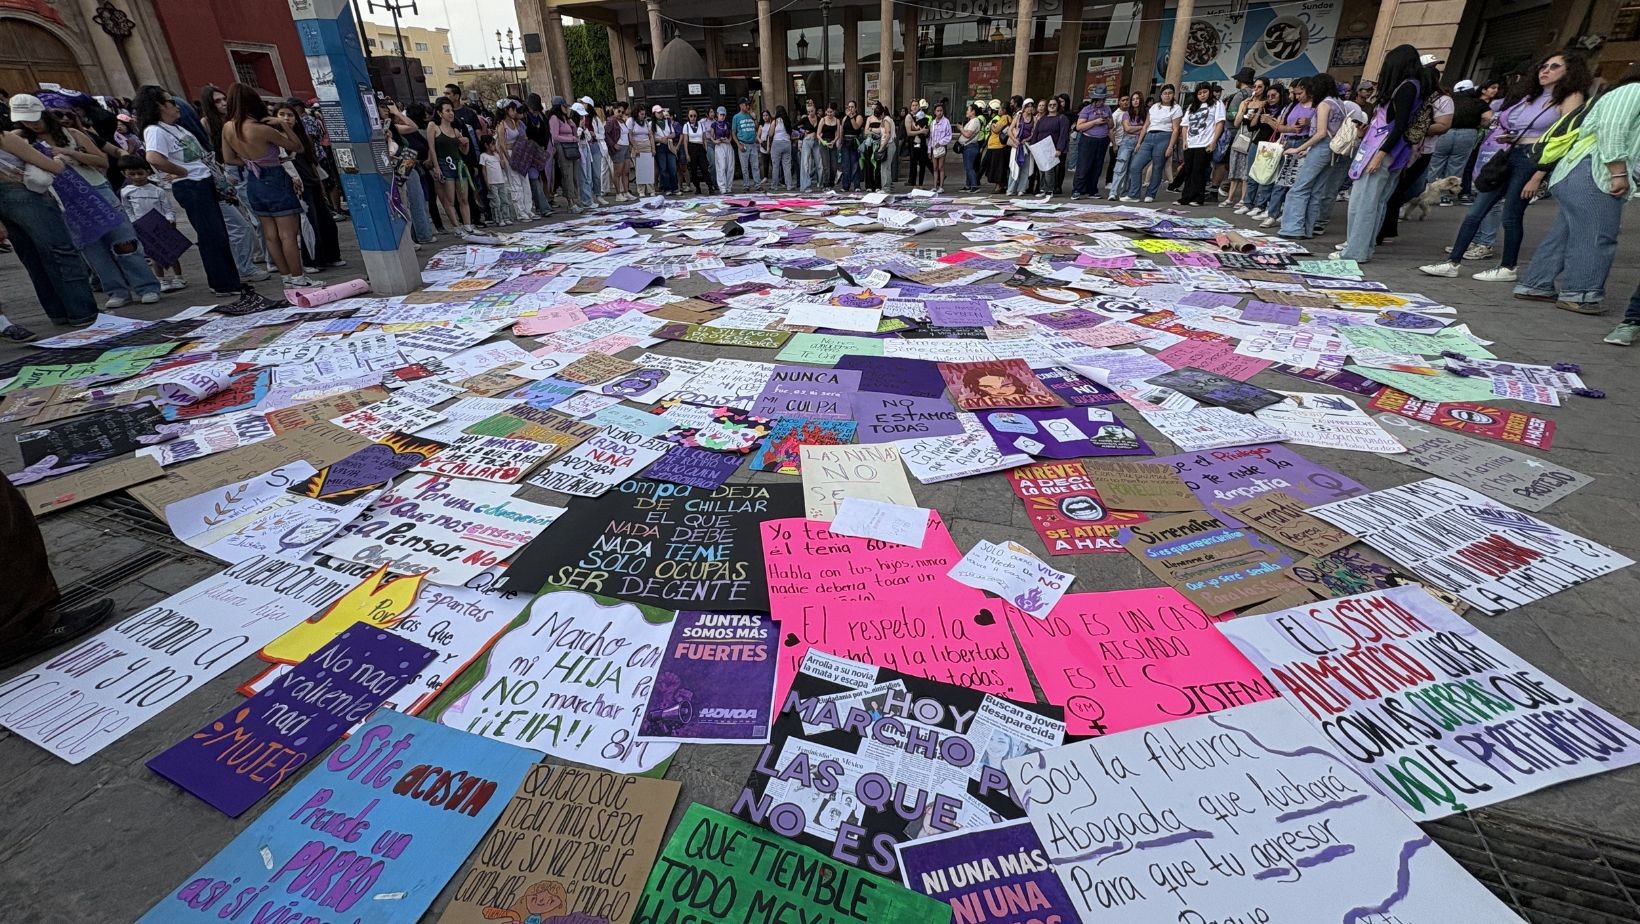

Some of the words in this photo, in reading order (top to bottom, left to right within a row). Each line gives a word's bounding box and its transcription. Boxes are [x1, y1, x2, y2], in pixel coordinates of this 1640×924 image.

[772, 371, 840, 385] NUNCA
[785, 400, 838, 414] CULPA
[876, 411, 957, 423] ESTAMOS
[869, 423, 930, 434] TODAS
[585, 449, 633, 468] NUNCA
[806, 449, 840, 463] LAS
[822, 463, 878, 481] NO
[1014, 464, 1087, 480] ATRÉVET
[709, 485, 770, 499] DEJA
[811, 486, 845, 502] SE
[1022, 487, 1039, 495] LO
[1042, 487, 1070, 495] QUE
[633, 497, 671, 511] DE
[684, 500, 768, 513] CHILLAR
[604, 520, 660, 539] NADA
[670, 527, 737, 543] DEBE
[645, 511, 675, 525] EL
[683, 514, 733, 528] QUE
[769, 523, 792, 541] Yo
[1046, 529, 1071, 539] SE
[1056, 540, 1072, 550] A
[462, 549, 497, 567] No
[592, 535, 652, 557] NADA
[665, 543, 734, 561] TEME
[980, 543, 1004, 557] SOLO
[579, 551, 647, 574] SOLO
[655, 560, 750, 581] OCUPAS
[769, 564, 811, 580] Habla
[820, 564, 841, 578] con
[849, 561, 873, 576] tus
[915, 557, 948, 568] nunca
[1038, 563, 1066, 581] VIVIR
[548, 565, 610, 593] SER
[617, 576, 752, 601] DECENTE
[771, 582, 809, 595] nadie
[874, 574, 917, 587] tocar
[918, 573, 936, 582] un
[1038, 577, 1061, 590] NO
[419, 586, 494, 622] Espantas
[532, 611, 634, 657] Marcho
[682, 627, 734, 639] SOMOS
[736, 626, 768, 639] MÁS
[695, 614, 762, 627] JUNTAS
[803, 605, 828, 645] El
[937, 606, 973, 642] la
[1080, 613, 1110, 637] ES
[1119, 608, 1155, 634] UN
[1276, 614, 1338, 656] EL
[1309, 594, 1437, 652] SISTEMA
[314, 645, 350, 673] No
[674, 643, 768, 662] FUERTES
[884, 650, 898, 672] y
[903, 645, 927, 667] la
[930, 640, 1010, 664] libertad
[1099, 636, 1190, 661] AISLADO
[1406, 630, 1510, 679] LUCRA
[509, 656, 541, 676] mi
[542, 652, 622, 695] HIJA
[803, 663, 811, 671] la
[812, 668, 832, 678] mata
[841, 675, 869, 689] escapa
[807, 656, 833, 670] Arrolla
[947, 668, 1004, 689] todas
[1064, 667, 1096, 690] ES
[1103, 664, 1129, 688] EL
[283, 671, 372, 723] valiente
[482, 676, 540, 706] NO
[542, 692, 625, 721] marchar
[1075, 702, 1094, 713] 8M
[882, 688, 975, 736] HOY
[981, 704, 1055, 741] desaparecida
[985, 694, 1024, 717] Buscan
[1033, 716, 1065, 732] joven
[1322, 706, 1397, 764] CON
[1366, 697, 1444, 747] LAS
[1489, 671, 1574, 710] QUE
[782, 690, 976, 768] MARCHO
[207, 727, 308, 791] MUJER
[600, 729, 649, 769] 8M
[754, 743, 845, 794] LAS
[1020, 753, 1097, 814] Soy
[1096, 744, 1141, 785] la
[1142, 727, 1255, 781] futura
[1416, 744, 1494, 795] LE
[731, 787, 806, 838] NO
[855, 772, 963, 832] QUE
[1046, 786, 1198, 867] Abogada
[1198, 786, 1257, 835] que
[1245, 764, 1359, 813] luchará
[289, 788, 382, 844] Prende
[371, 830, 413, 860] un
[268, 840, 385, 914] PORRO
[684, 816, 748, 868] QUE
[748, 836, 878, 923] TIEMBLE
[921, 868, 950, 895] NI
[948, 857, 1000, 889] UNA
[1070, 862, 1141, 915] Para
[1146, 859, 1210, 905] que
[1195, 839, 1247, 881] tu
[1250, 814, 1345, 884] agresor
[655, 855, 738, 919] TODO
[950, 892, 987, 924] NI
[983, 880, 1052, 919] UNA
